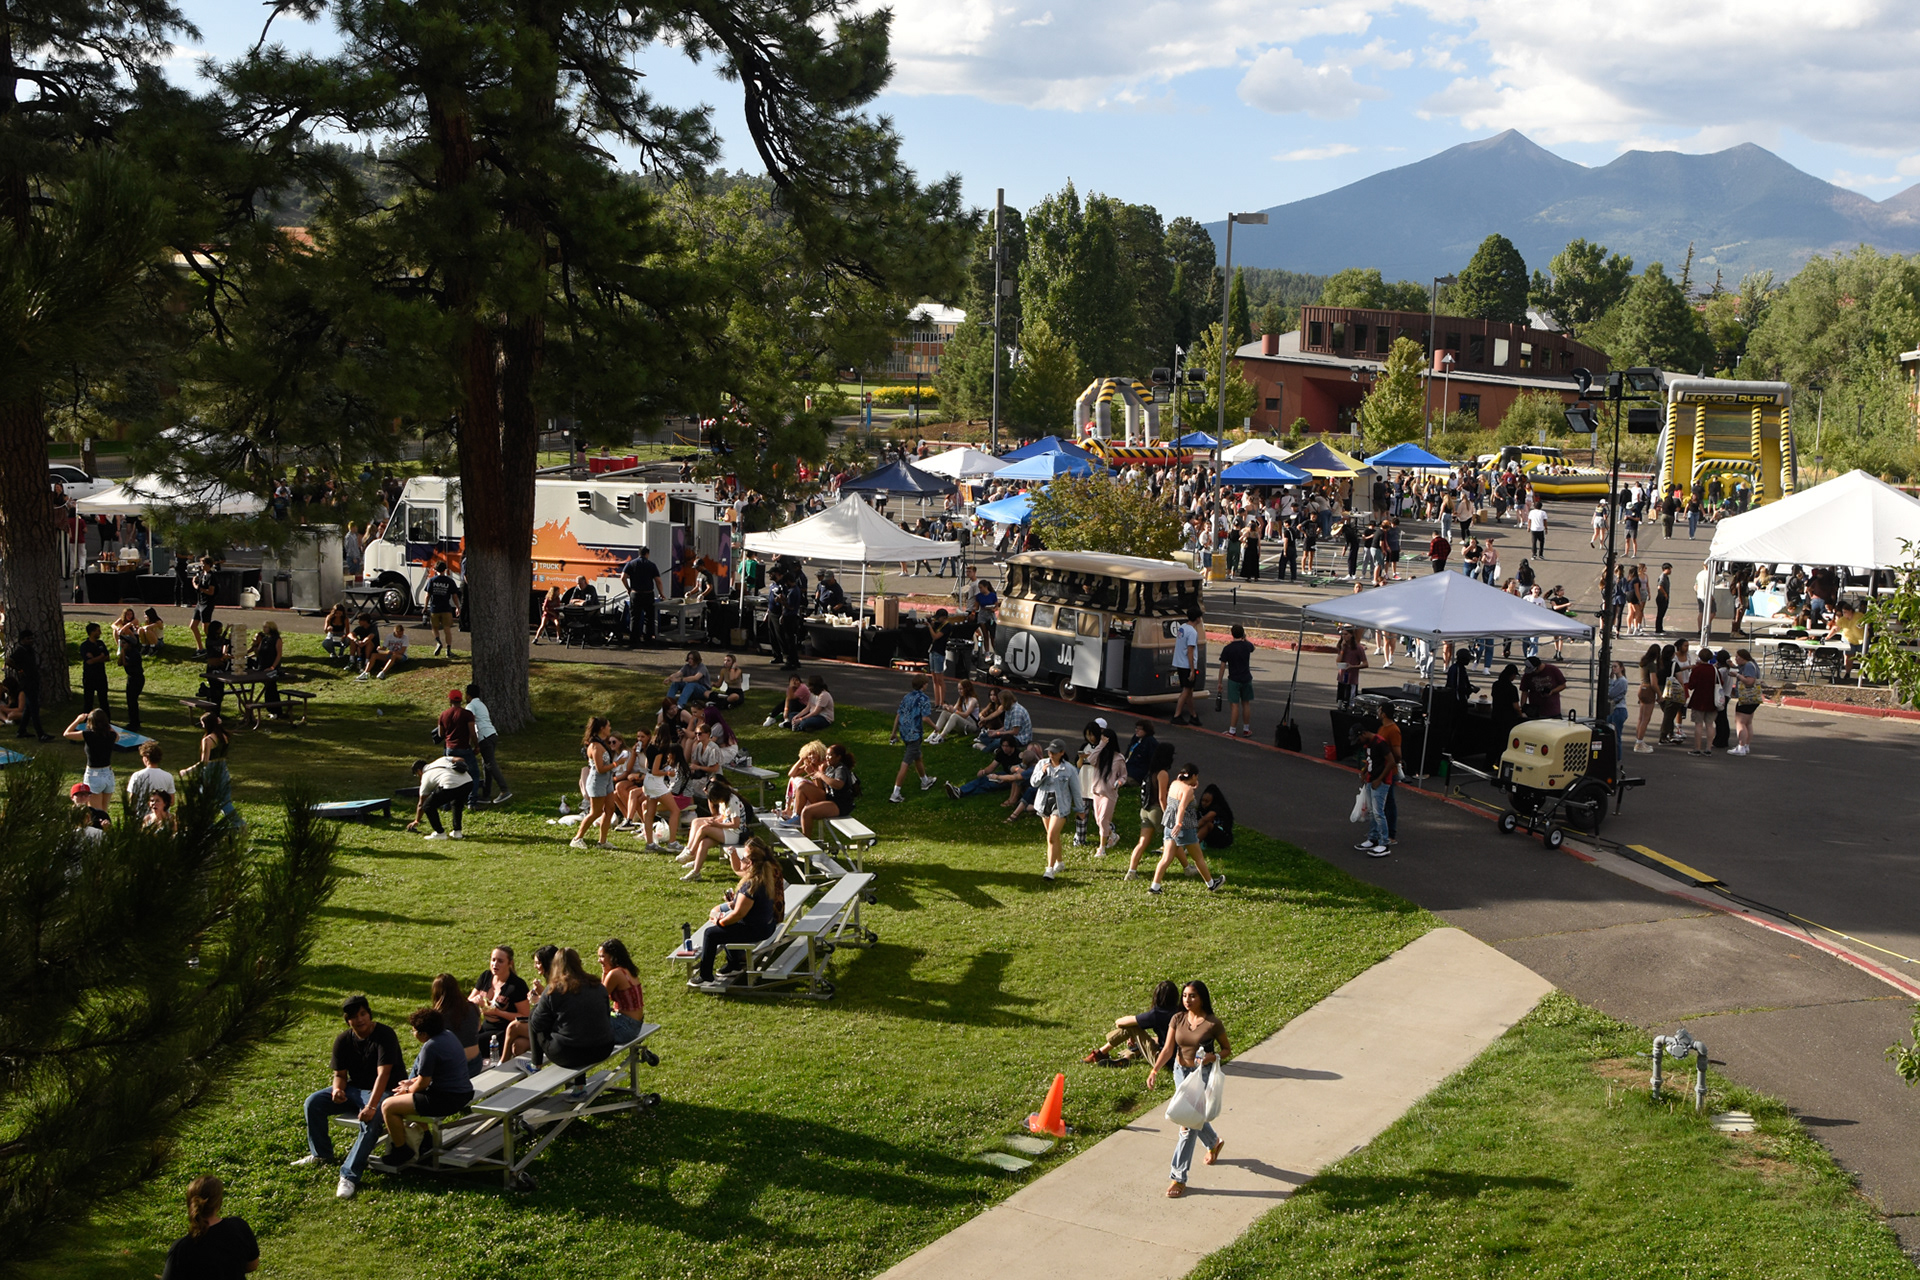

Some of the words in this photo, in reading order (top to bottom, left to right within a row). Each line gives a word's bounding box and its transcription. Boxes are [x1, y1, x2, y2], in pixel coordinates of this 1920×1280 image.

[1686, 394, 1735, 402] TOXIC
[1738, 395, 1774, 403] RUSH
[648, 495, 665, 511] WTF
[1002, 601, 1022, 610] BREW
[1001, 609, 1029, 619] BAKERY
[1057, 643, 1075, 667] JA
